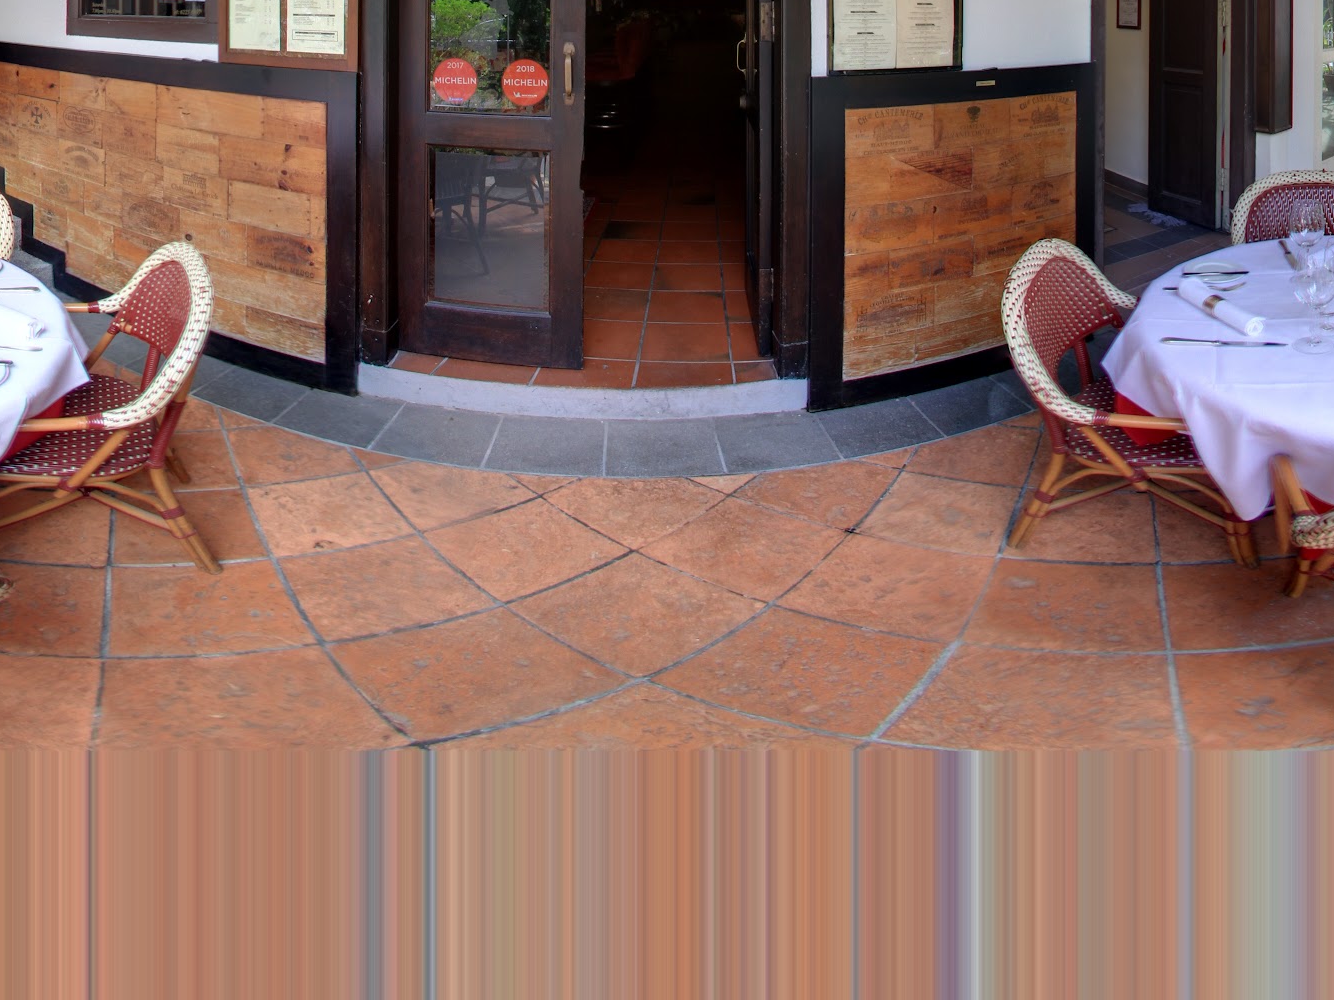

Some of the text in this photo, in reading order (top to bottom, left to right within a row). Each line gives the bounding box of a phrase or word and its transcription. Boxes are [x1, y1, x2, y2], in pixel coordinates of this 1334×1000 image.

[516, 65, 535, 73] 2018
[434, 77, 477, 85] MICHELIN
[504, 79, 548, 87] MICHELIN
